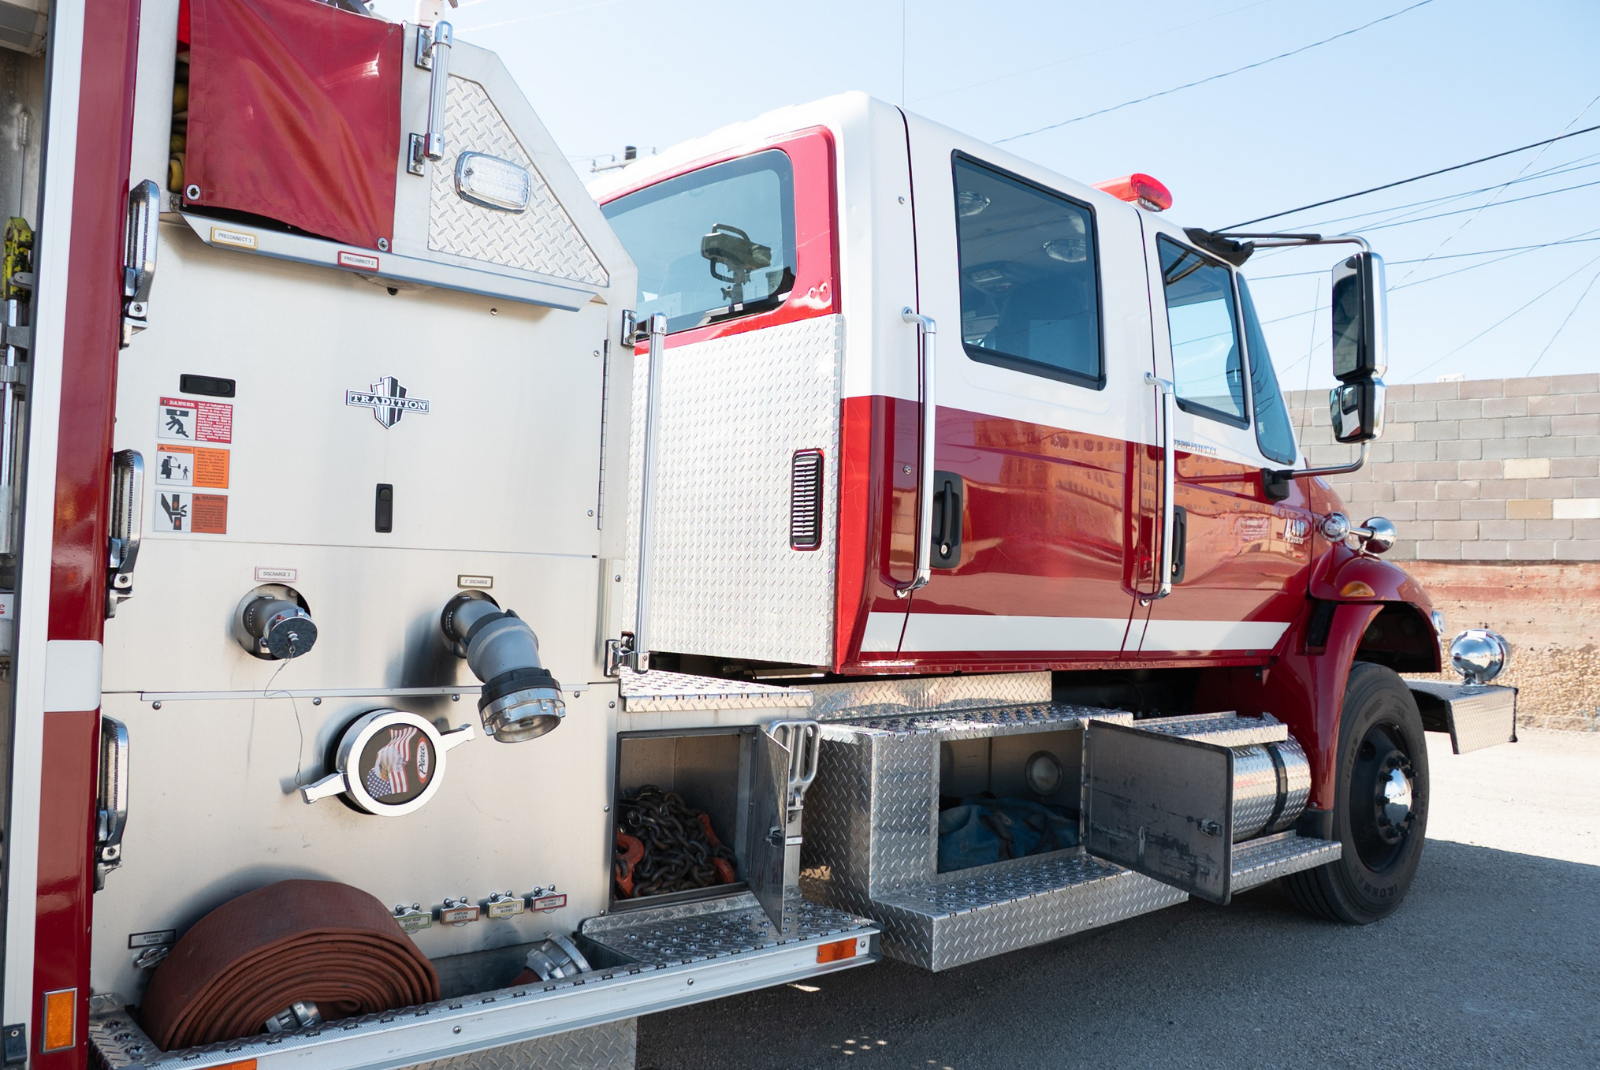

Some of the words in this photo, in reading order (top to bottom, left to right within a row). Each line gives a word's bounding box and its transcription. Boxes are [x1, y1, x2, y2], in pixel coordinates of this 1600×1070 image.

[217, 232, 248, 243] PRECONNECT
[343, 255, 371, 265] PRECONNECT
[351, 394, 427, 410] TRADITION
[418, 744, 427, 775] Pierce
